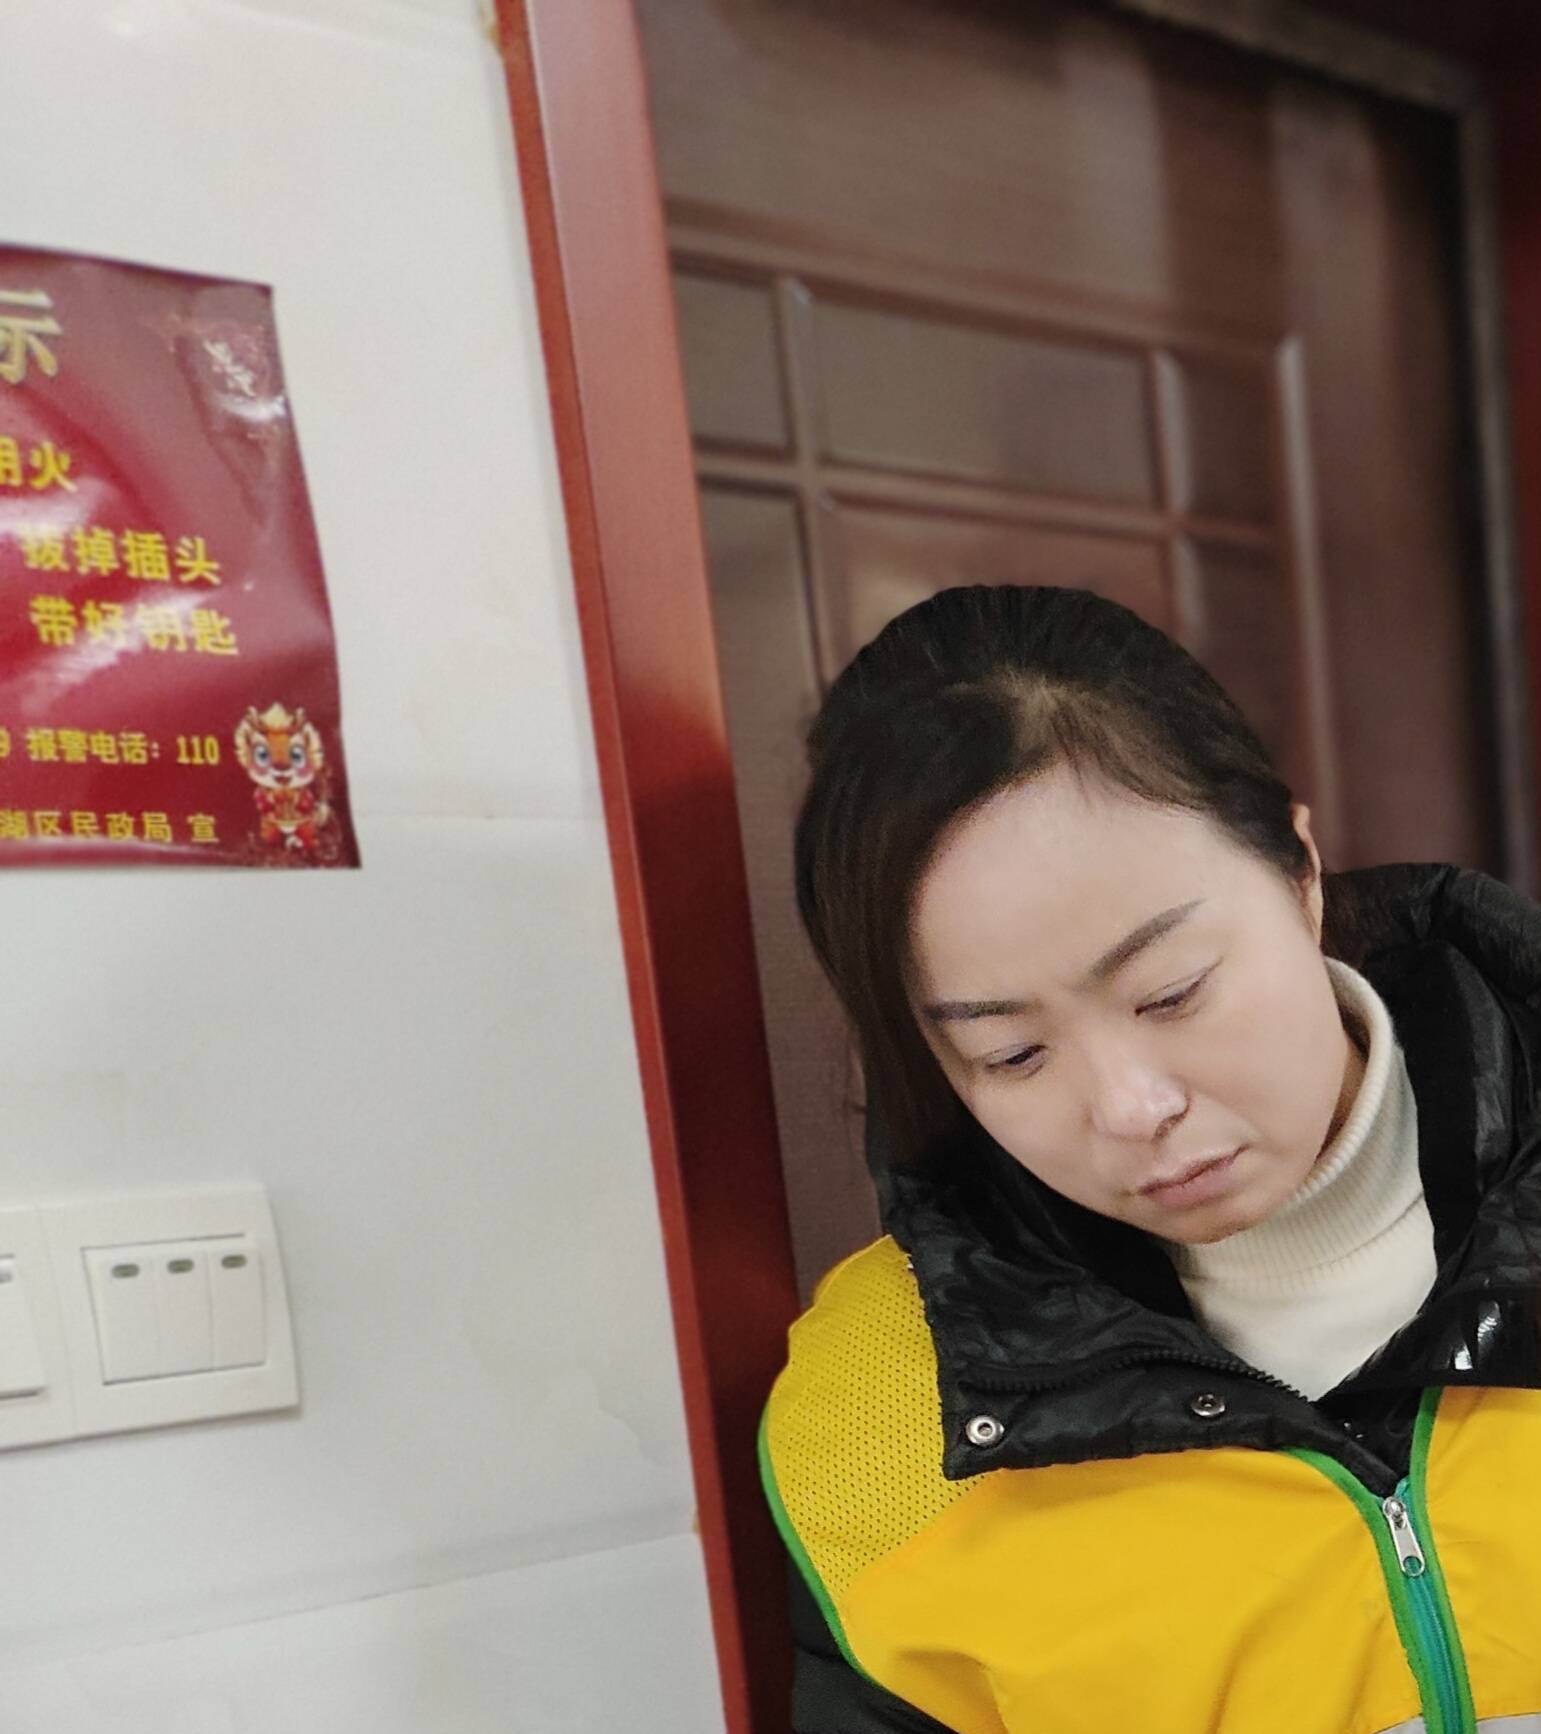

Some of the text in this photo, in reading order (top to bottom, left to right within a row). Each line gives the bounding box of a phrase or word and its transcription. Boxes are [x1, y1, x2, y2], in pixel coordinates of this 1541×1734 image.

[0, 289, 63, 384] 示
[30, 595, 239, 656] 带好钥匙
